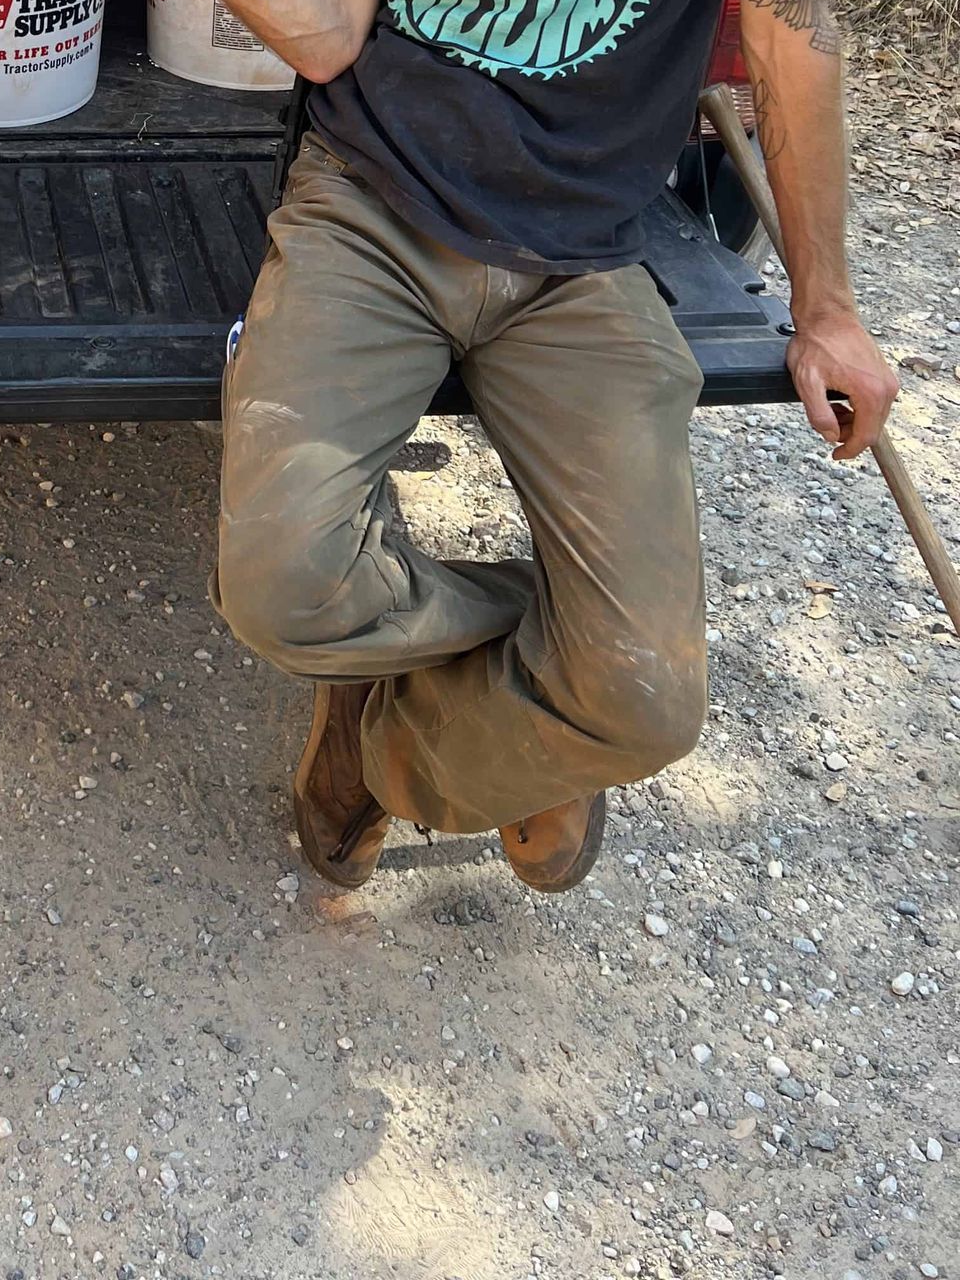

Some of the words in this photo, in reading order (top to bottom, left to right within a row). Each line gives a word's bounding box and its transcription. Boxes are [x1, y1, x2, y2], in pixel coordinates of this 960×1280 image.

[3, 43, 91, 75] TractorSupply.com
[14, 45, 49, 60] LIFE
[55, 35, 79, 53] OUT
